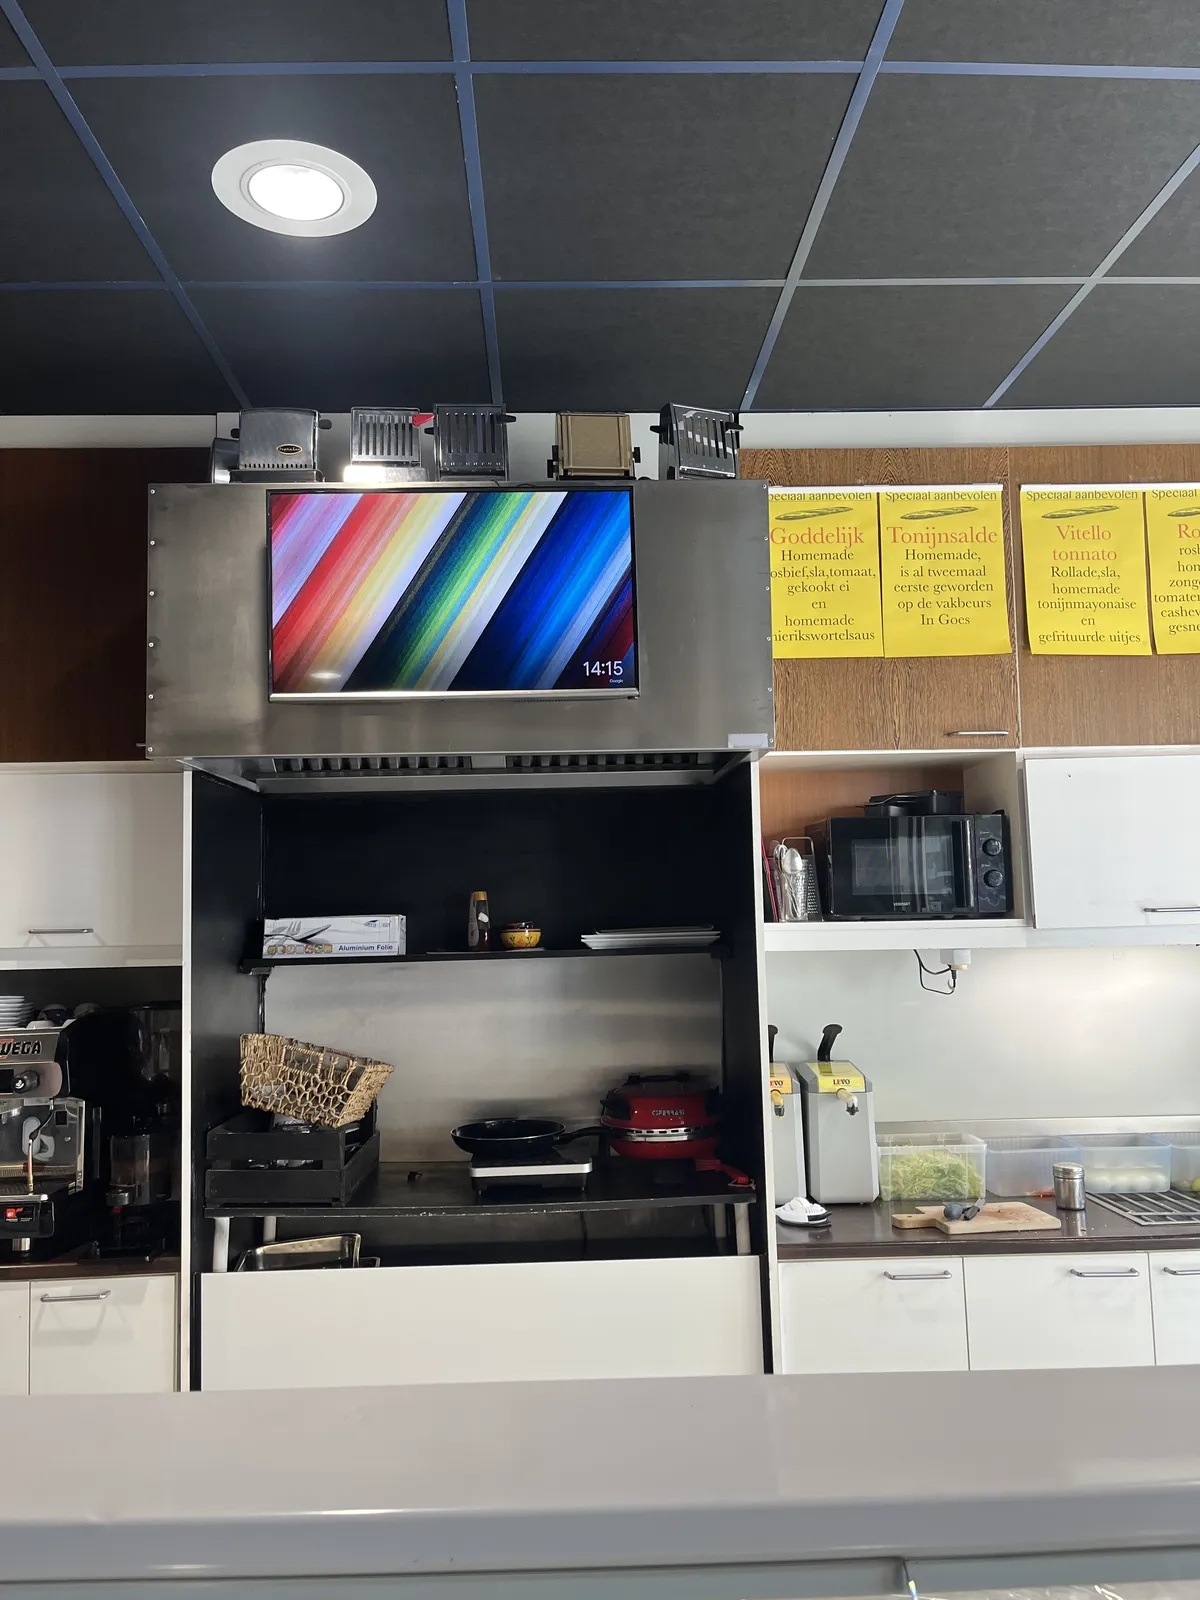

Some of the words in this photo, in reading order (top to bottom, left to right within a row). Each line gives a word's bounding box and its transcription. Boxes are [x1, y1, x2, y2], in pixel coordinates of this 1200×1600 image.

[809, 491, 872, 501] aanbevolen
[885, 491, 931, 503] Speciaal
[934, 490, 997, 500] aanbevolen
[1026, 490, 1072, 502] Speciaal
[1075, 489, 1138, 499] aanbevolen
[769, 526, 865, 549] Goddelijk
[886, 526, 998, 549] Tonijnsalde
[1056, 525, 1112, 541] Vitello
[1177, 523, 1200, 539] Ro
[780, 549, 855, 561] Homemade
[904, 548, 981, 562] Homemade,
[1052, 548, 1118, 561] tonnato
[900, 565, 910, 577] is
[912, 565, 924, 577] al
[927, 564, 987, 577] tweemaal
[1051, 566, 1121, 579] Rollade,sla,
[787, 581, 835, 596] gekookt
[839, 580, 850, 592] ei
[893, 583, 930, 592] eerste
[933, 580, 994, 596] geworden
[1052, 583, 1121, 594] homemade
[1169, 578, 1200, 590] zong
[811, 600, 827, 609] en
[897, 600, 914, 612] op
[917, 597, 932, 609] de
[936, 597, 992, 609] vakbeurs
[1037, 597, 1137, 612] tonijnmayonaise
[785, 614, 855, 627] homemade
[920, 613, 935, 625] In
[938, 613, 971, 625] Goes
[1080, 617, 1096, 626] en
[1038, 630, 1106, 645] gefrituurde
[1109, 630, 1141, 646] uitjes
[583, 660, 624, 677] 14:15
[832, 1078, 851, 1086] LEVO
